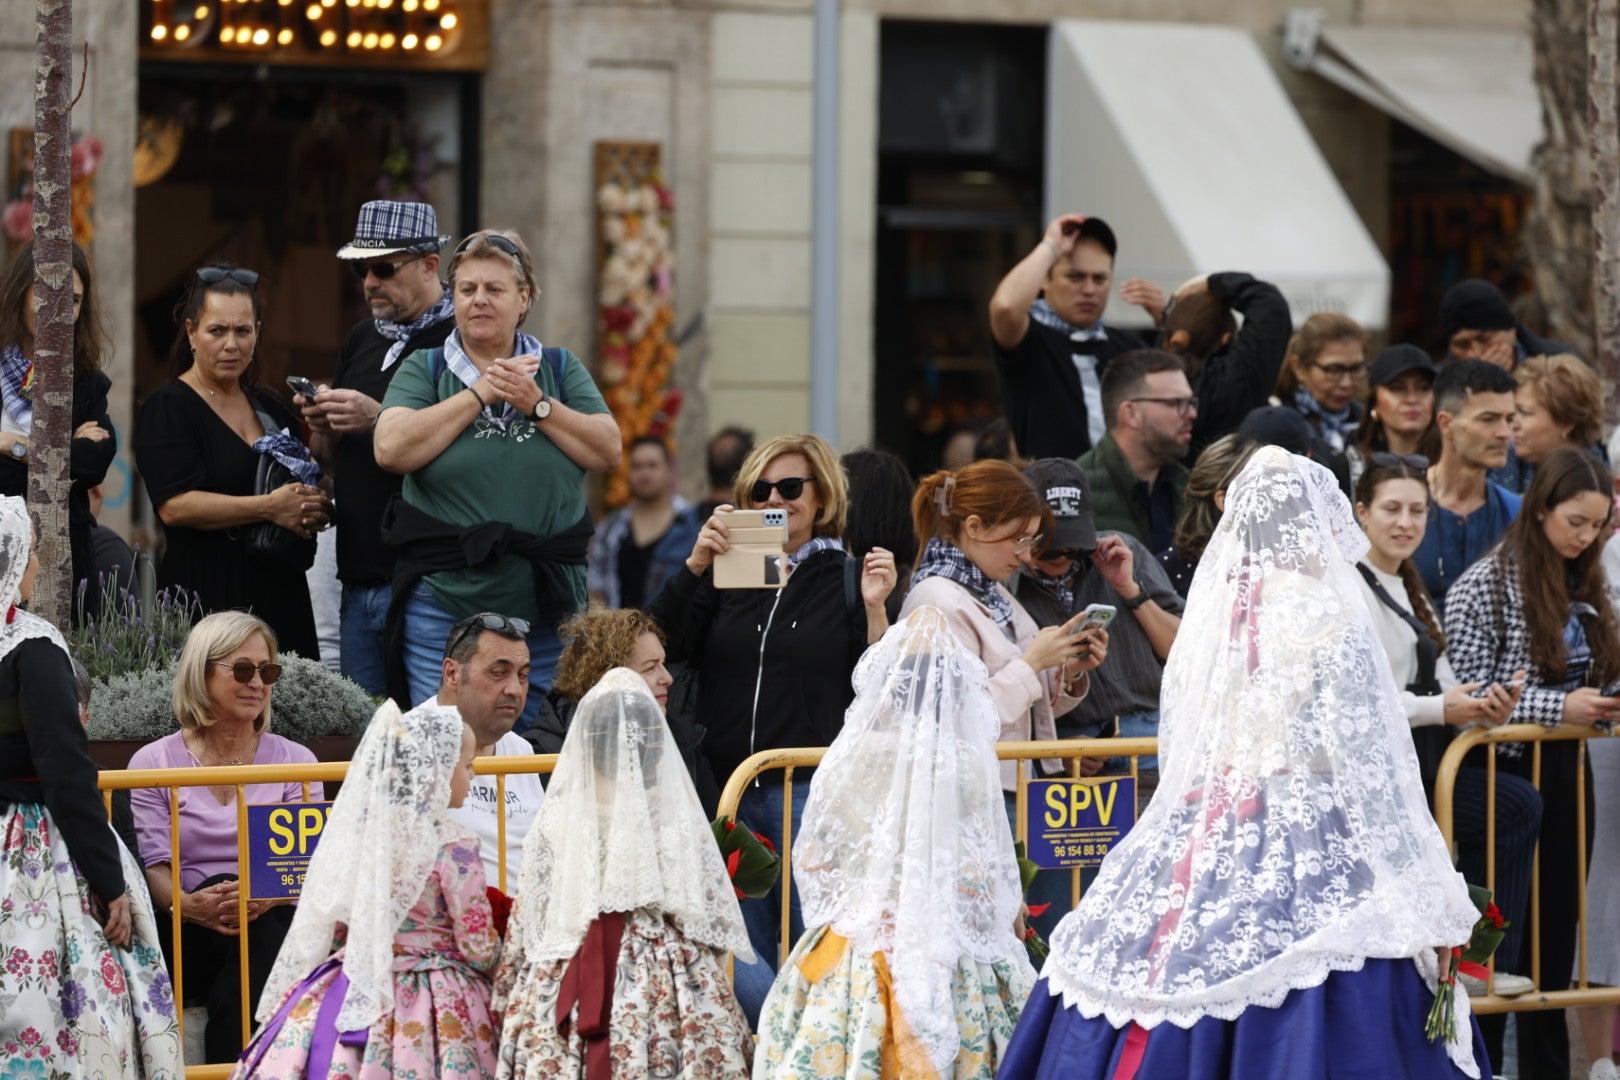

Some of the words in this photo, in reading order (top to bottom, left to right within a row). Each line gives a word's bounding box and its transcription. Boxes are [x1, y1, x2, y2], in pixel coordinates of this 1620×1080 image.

[1046, 487, 1081, 500] LIBERTY
[1044, 782, 1118, 828] SPV
[268, 808, 332, 855] SP
[1054, 846, 1065, 857] 96
[1067, 845, 1082, 857] 154
[1083, 844, 1095, 856] 88
[1096, 843, 1108, 855] 30
[281, 874, 294, 885] 96
